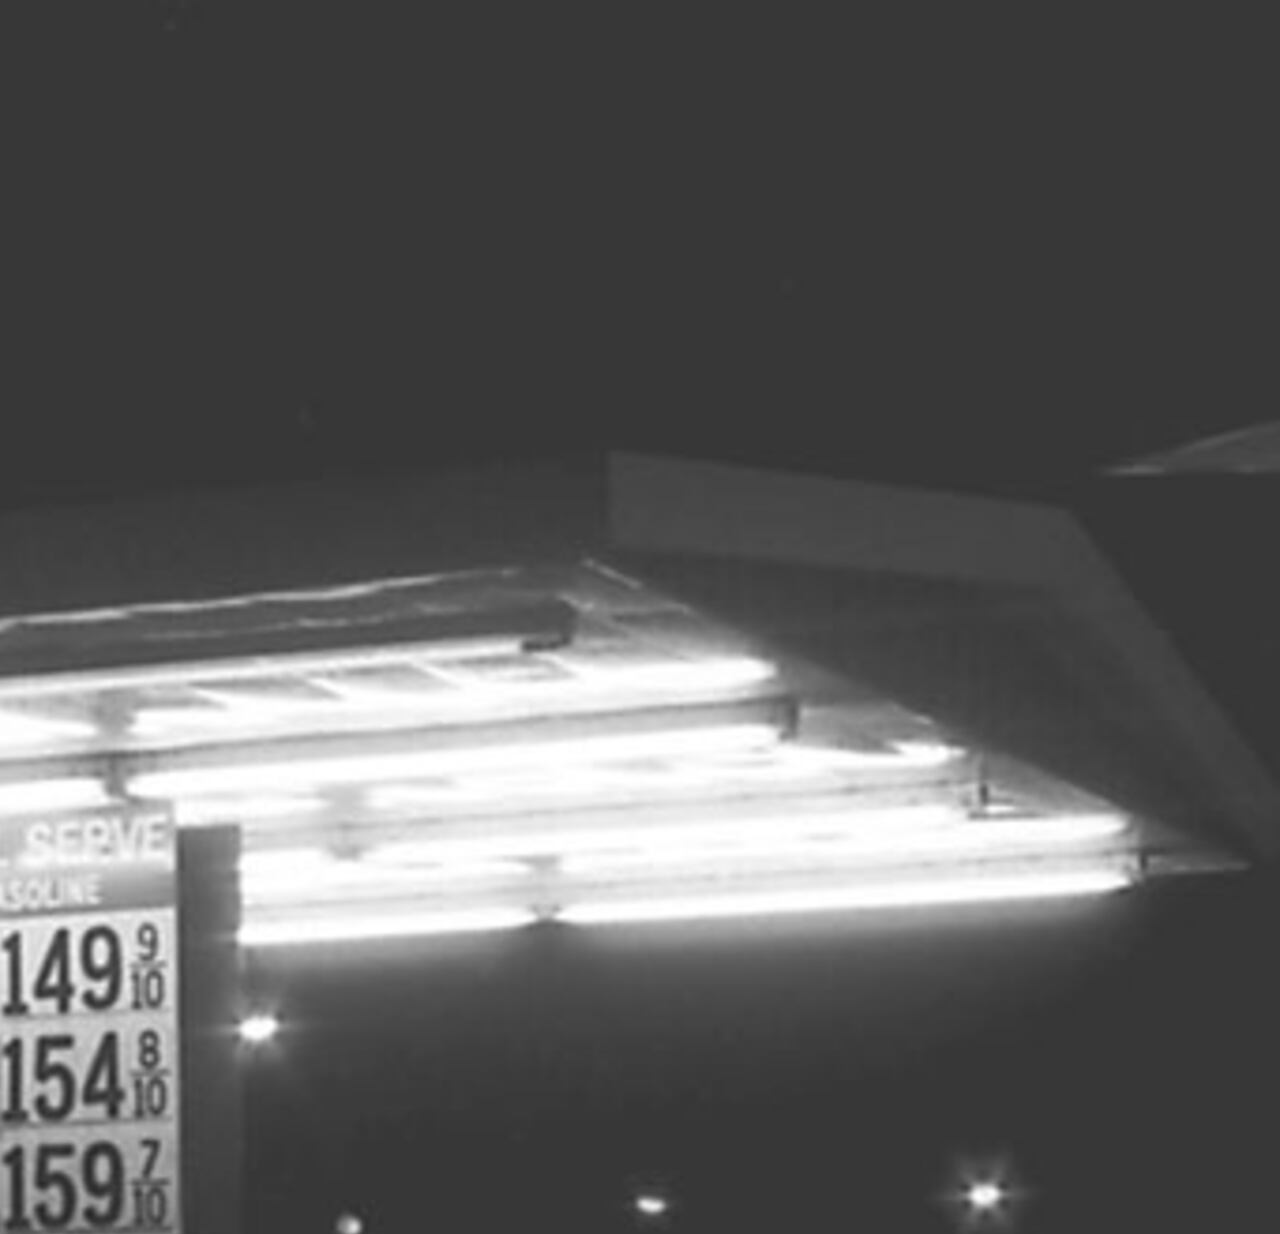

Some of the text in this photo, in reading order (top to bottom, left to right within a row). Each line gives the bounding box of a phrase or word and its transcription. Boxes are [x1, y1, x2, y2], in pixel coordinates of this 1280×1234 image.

[18, 816, 168, 868] SERVE
[1, 924, 122, 1016] 149
[1, 1031, 125, 1122] 154
[1, 1139, 126, 1231] 159
